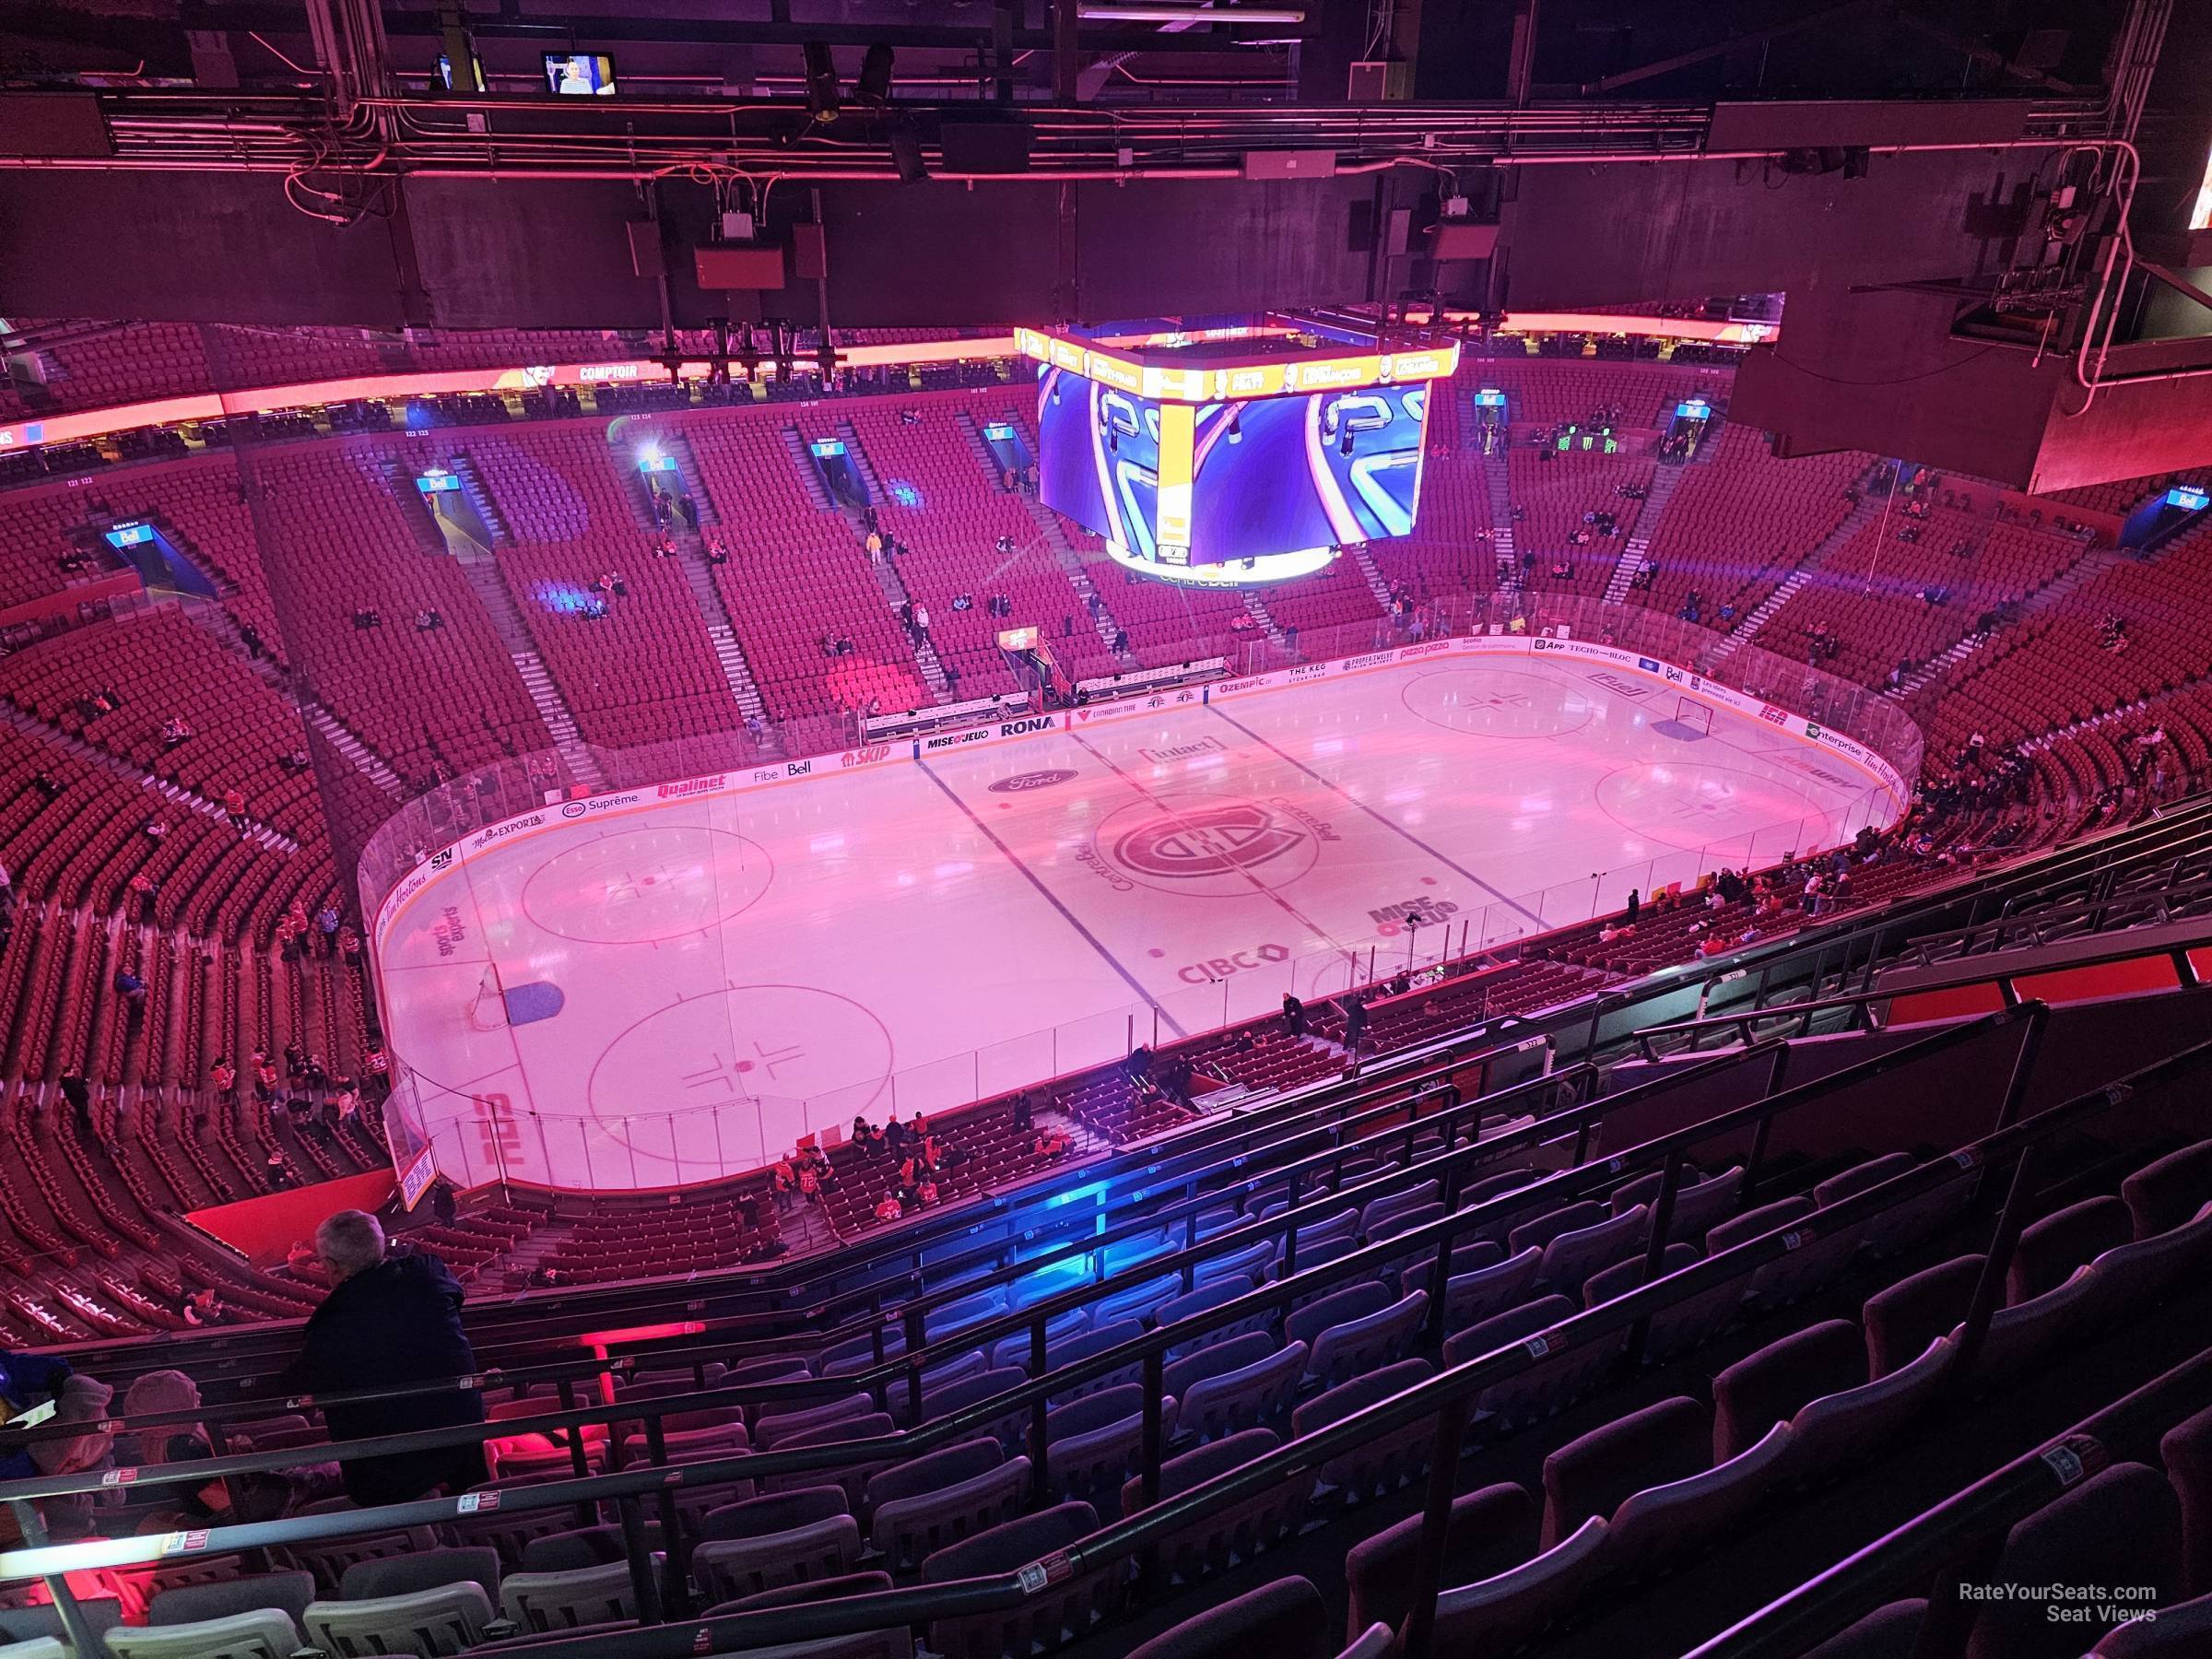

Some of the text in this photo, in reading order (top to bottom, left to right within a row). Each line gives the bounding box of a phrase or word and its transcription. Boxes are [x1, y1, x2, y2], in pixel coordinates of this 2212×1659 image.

[580, 366, 638, 380] COMPTOIR
[1400, 641, 1450, 659] pizza pizza
[1309, 664, 1326, 672] KEG
[1665, 666, 1683, 683] Bell
[1093, 704, 1136, 718] CANADIAN TIRE
[1758, 704, 1789, 726] IGA
[1001, 716, 1055, 736] RONA
[1150, 741, 1217, 759] intact
[1808, 727, 1862, 757] enterprise
[856, 747, 890, 765] SKIP
[754, 761, 811, 782] Fibe Bell
[1008, 774, 1061, 789] Ford
[657, 775, 726, 798] Qualinet
[566, 793, 639, 815] Esso Suprême
[431, 848, 453, 869] SN
[383, 874, 426, 924] Tim Hortons
[1367, 896, 1435, 924] MISE
[443, 906, 467, 942] experts
[432, 924, 456, 957] sports
[1177, 950, 1259, 985] CIBC
